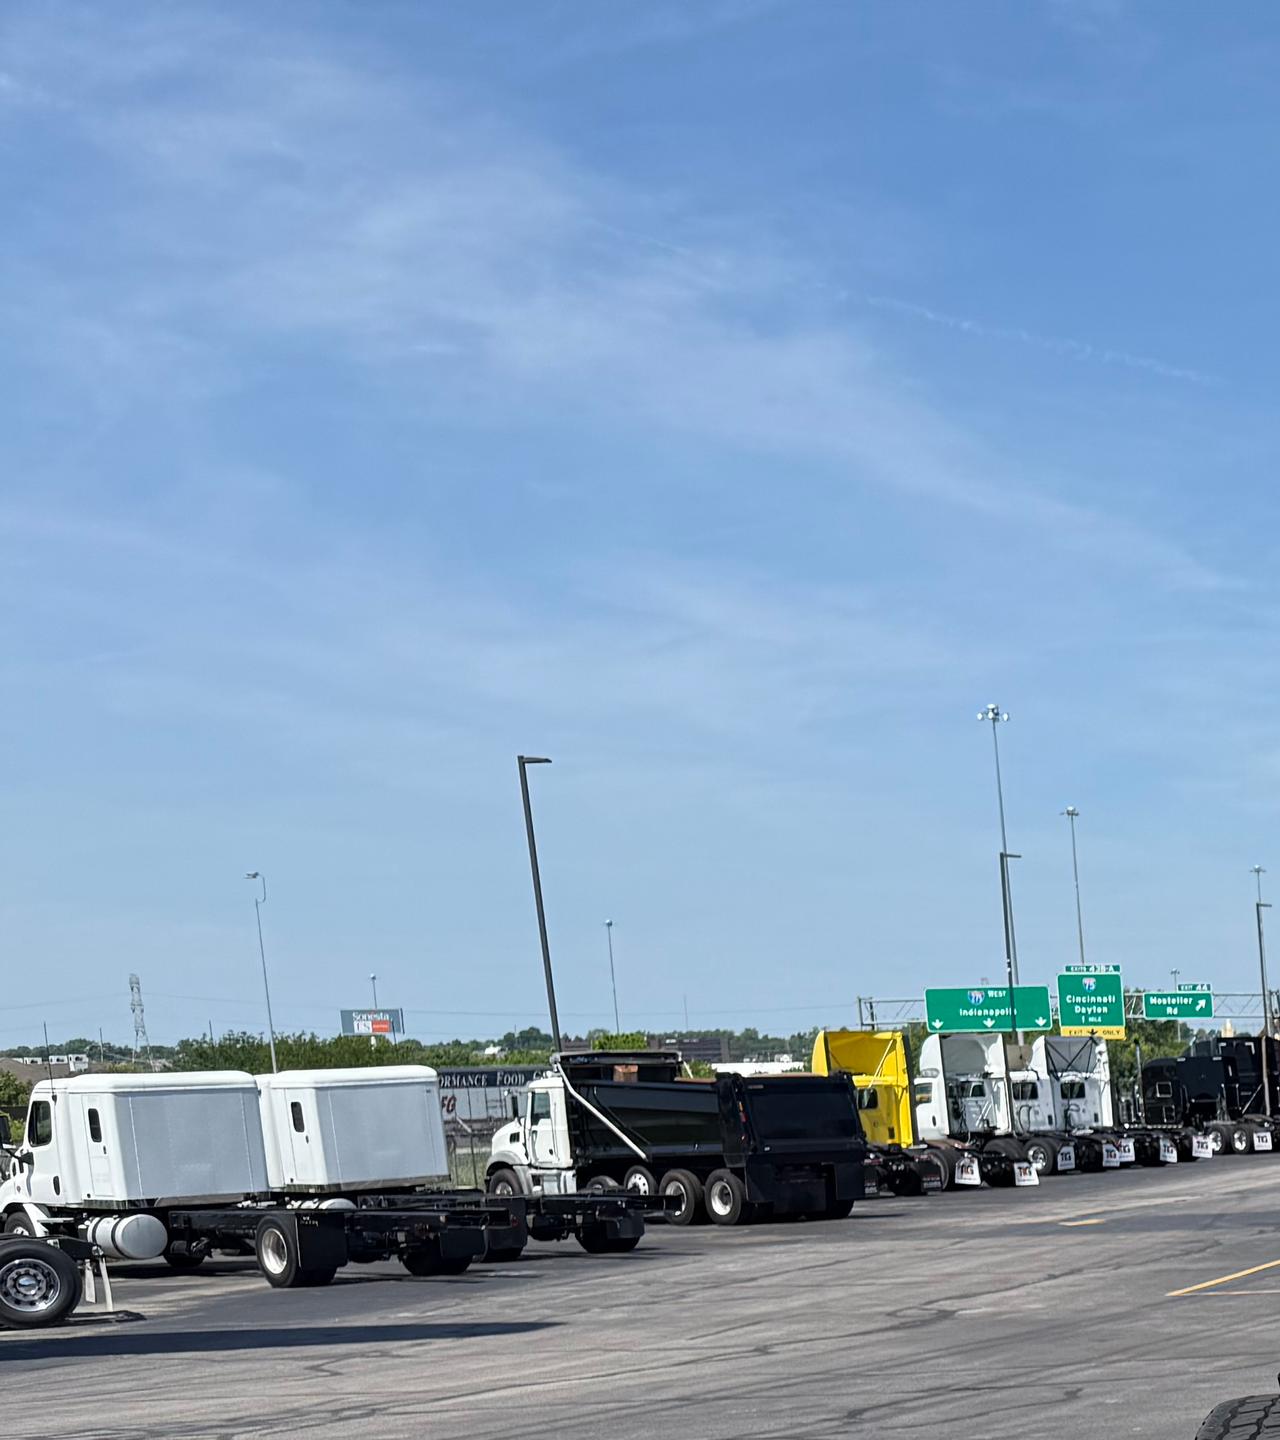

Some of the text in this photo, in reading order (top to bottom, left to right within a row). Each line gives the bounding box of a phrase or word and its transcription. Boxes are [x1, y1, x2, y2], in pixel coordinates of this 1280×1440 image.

[987, 990, 1006, 998] WEST
[1066, 995, 1116, 1004] Cincinnati
[1074, 1005, 1108, 1015] Dayton
[1166, 1006, 1178, 1015] Rd
